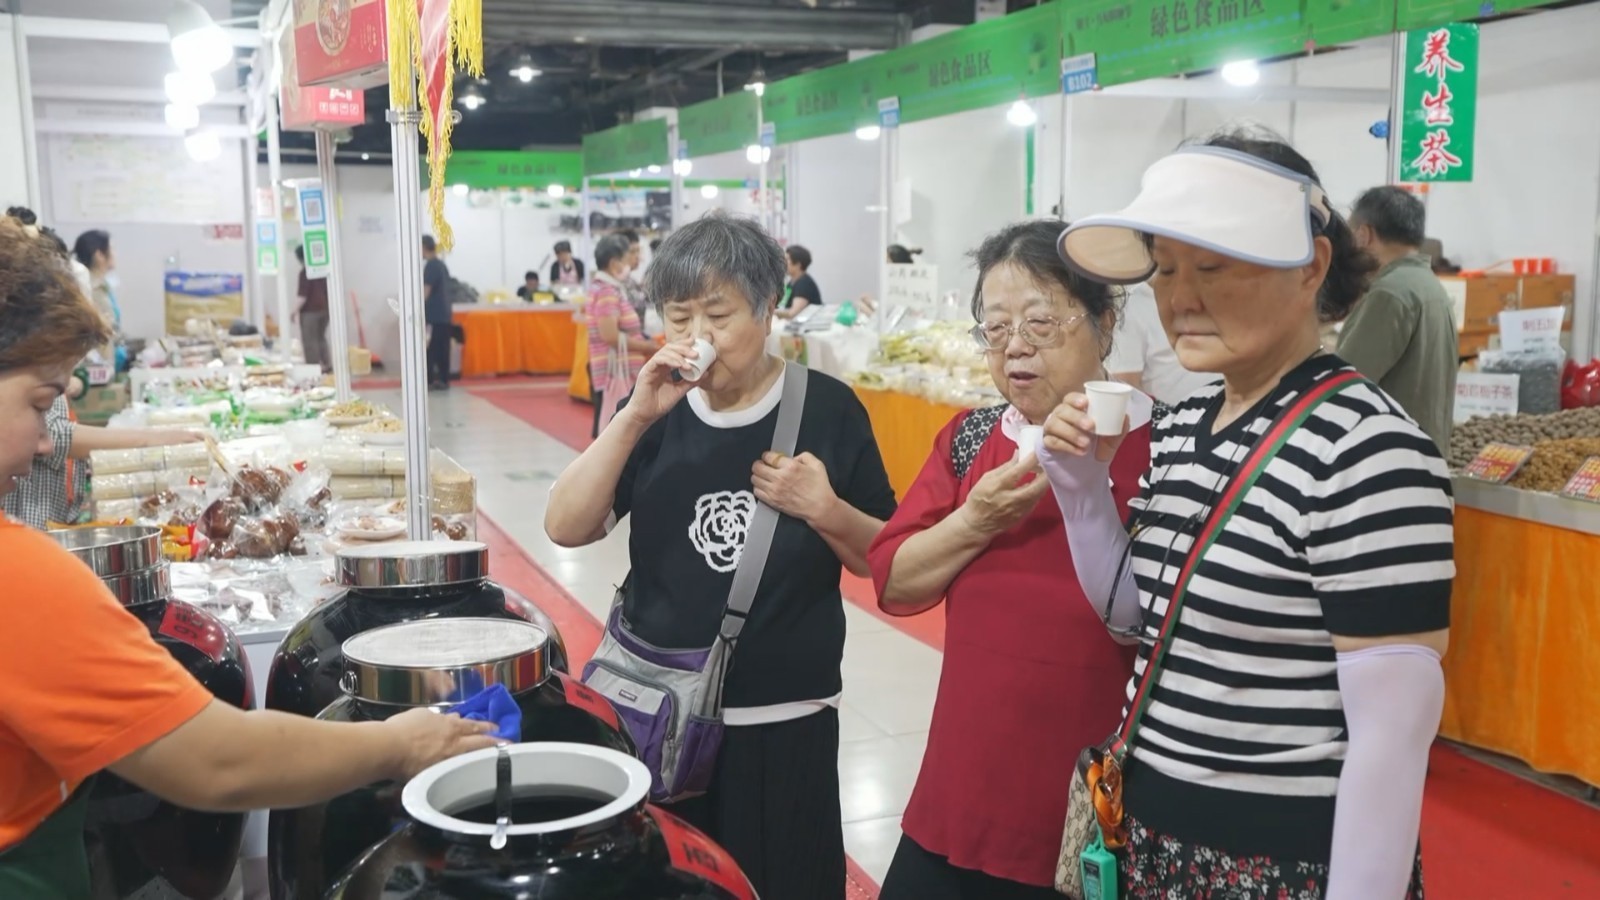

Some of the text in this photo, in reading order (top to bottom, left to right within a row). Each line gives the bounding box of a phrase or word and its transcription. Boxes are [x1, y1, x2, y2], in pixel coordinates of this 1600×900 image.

[1149, 0, 1266, 38] 绿色食品区
[1067, 72, 1093, 91] B102
[1413, 29, 1463, 175] 养生茶
